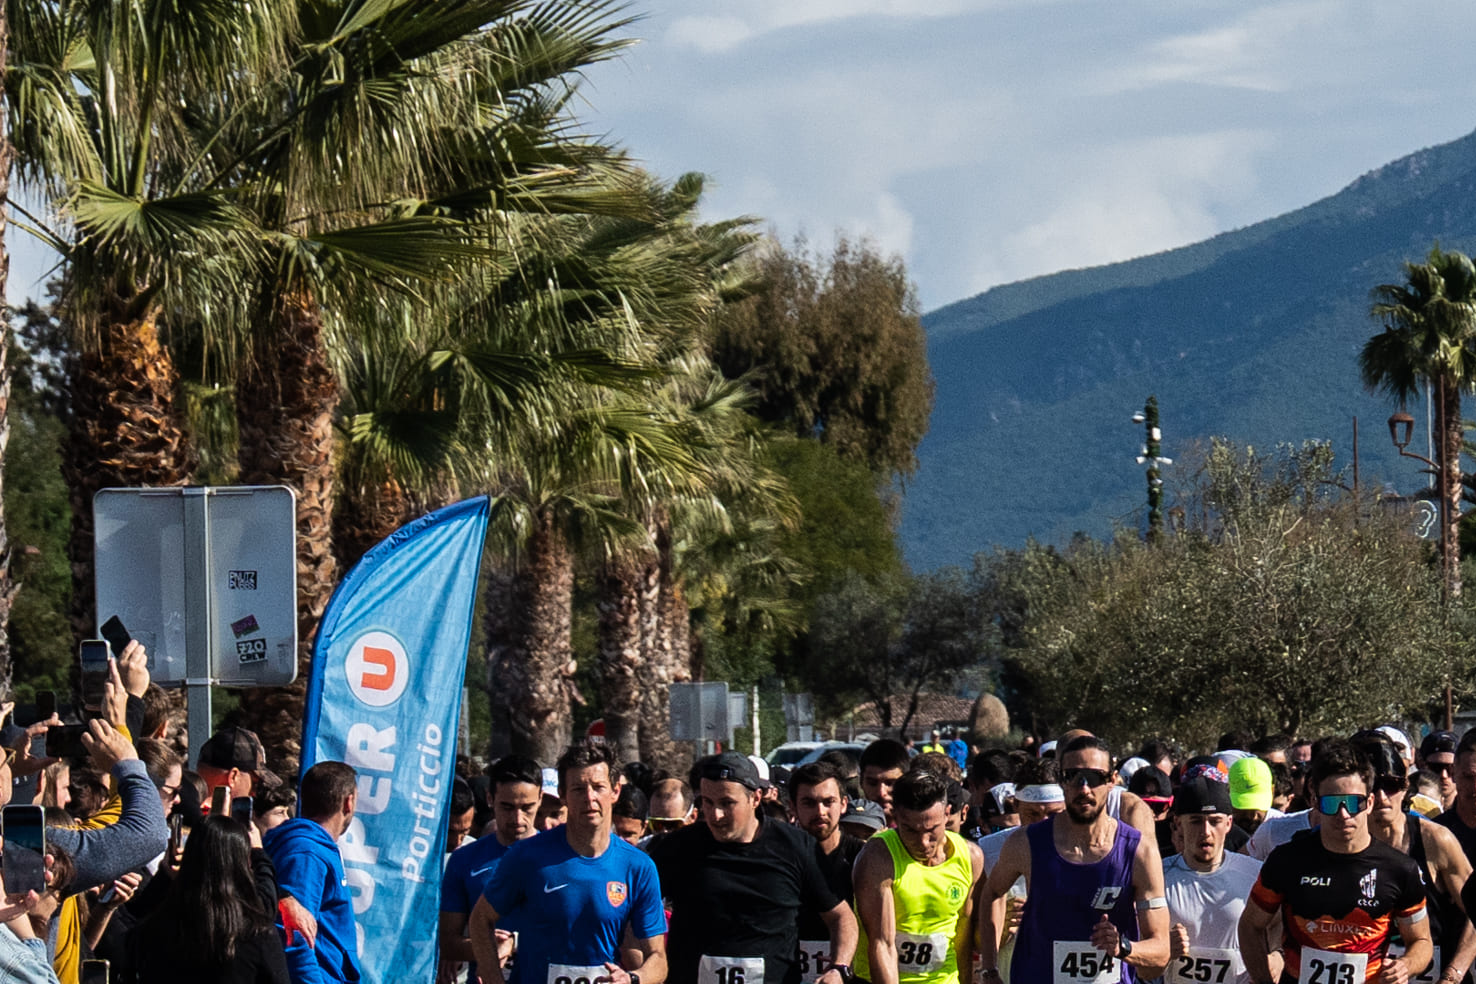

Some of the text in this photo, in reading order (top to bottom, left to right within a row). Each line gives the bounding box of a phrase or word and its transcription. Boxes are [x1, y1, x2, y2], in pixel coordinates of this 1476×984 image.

[239, 651, 265, 663] CREW
[361, 646, 396, 691] U
[402, 723, 442, 883] Porticcio
[338, 722, 397, 960] UPER
[1300, 876, 1331, 887] POLI
[899, 941, 933, 965] 38
[1060, 952, 1115, 978] 454
[1178, 955, 1231, 984] 257
